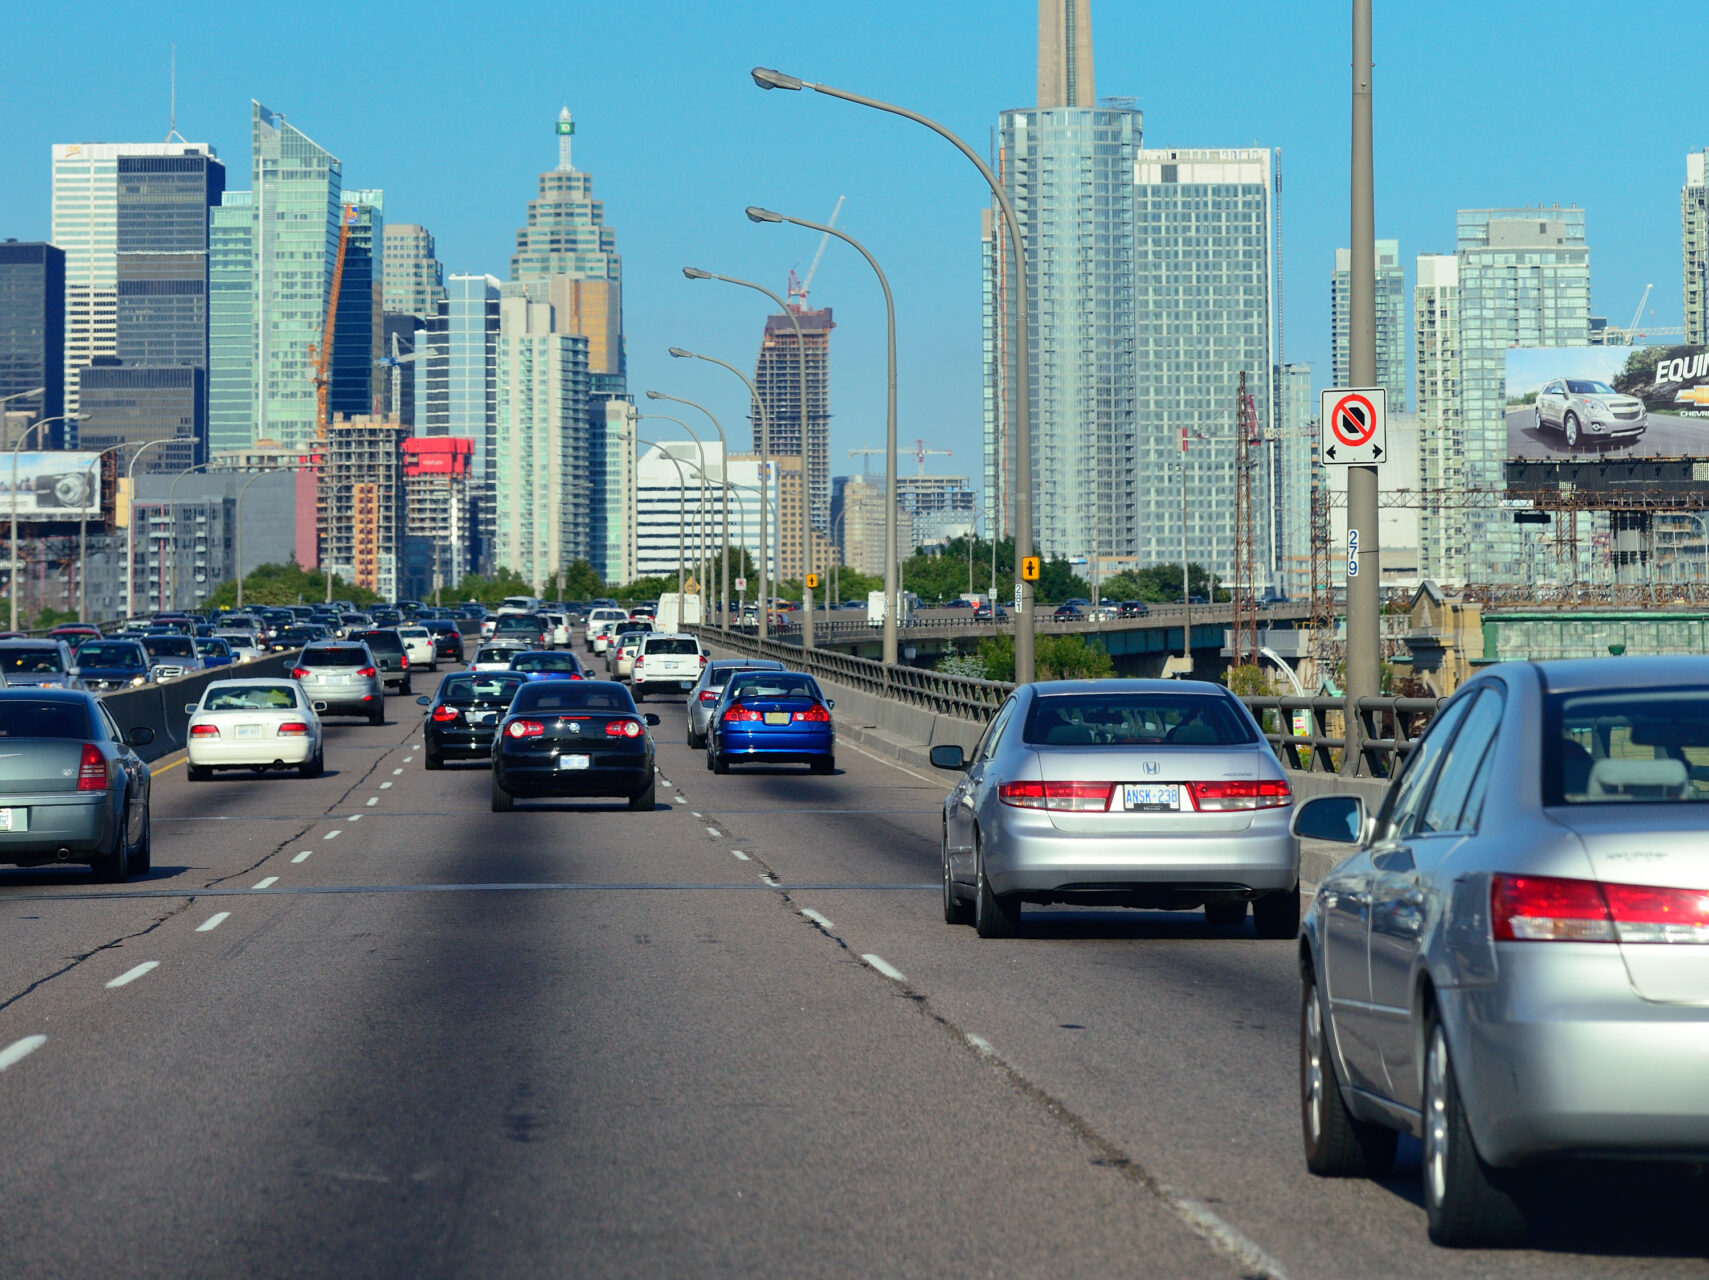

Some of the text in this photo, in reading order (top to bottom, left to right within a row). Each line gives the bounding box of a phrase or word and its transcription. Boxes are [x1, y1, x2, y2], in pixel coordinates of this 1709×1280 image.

[1349, 530, 1358, 575] 279
[1126, 789, 1178, 803] ANSK 238
